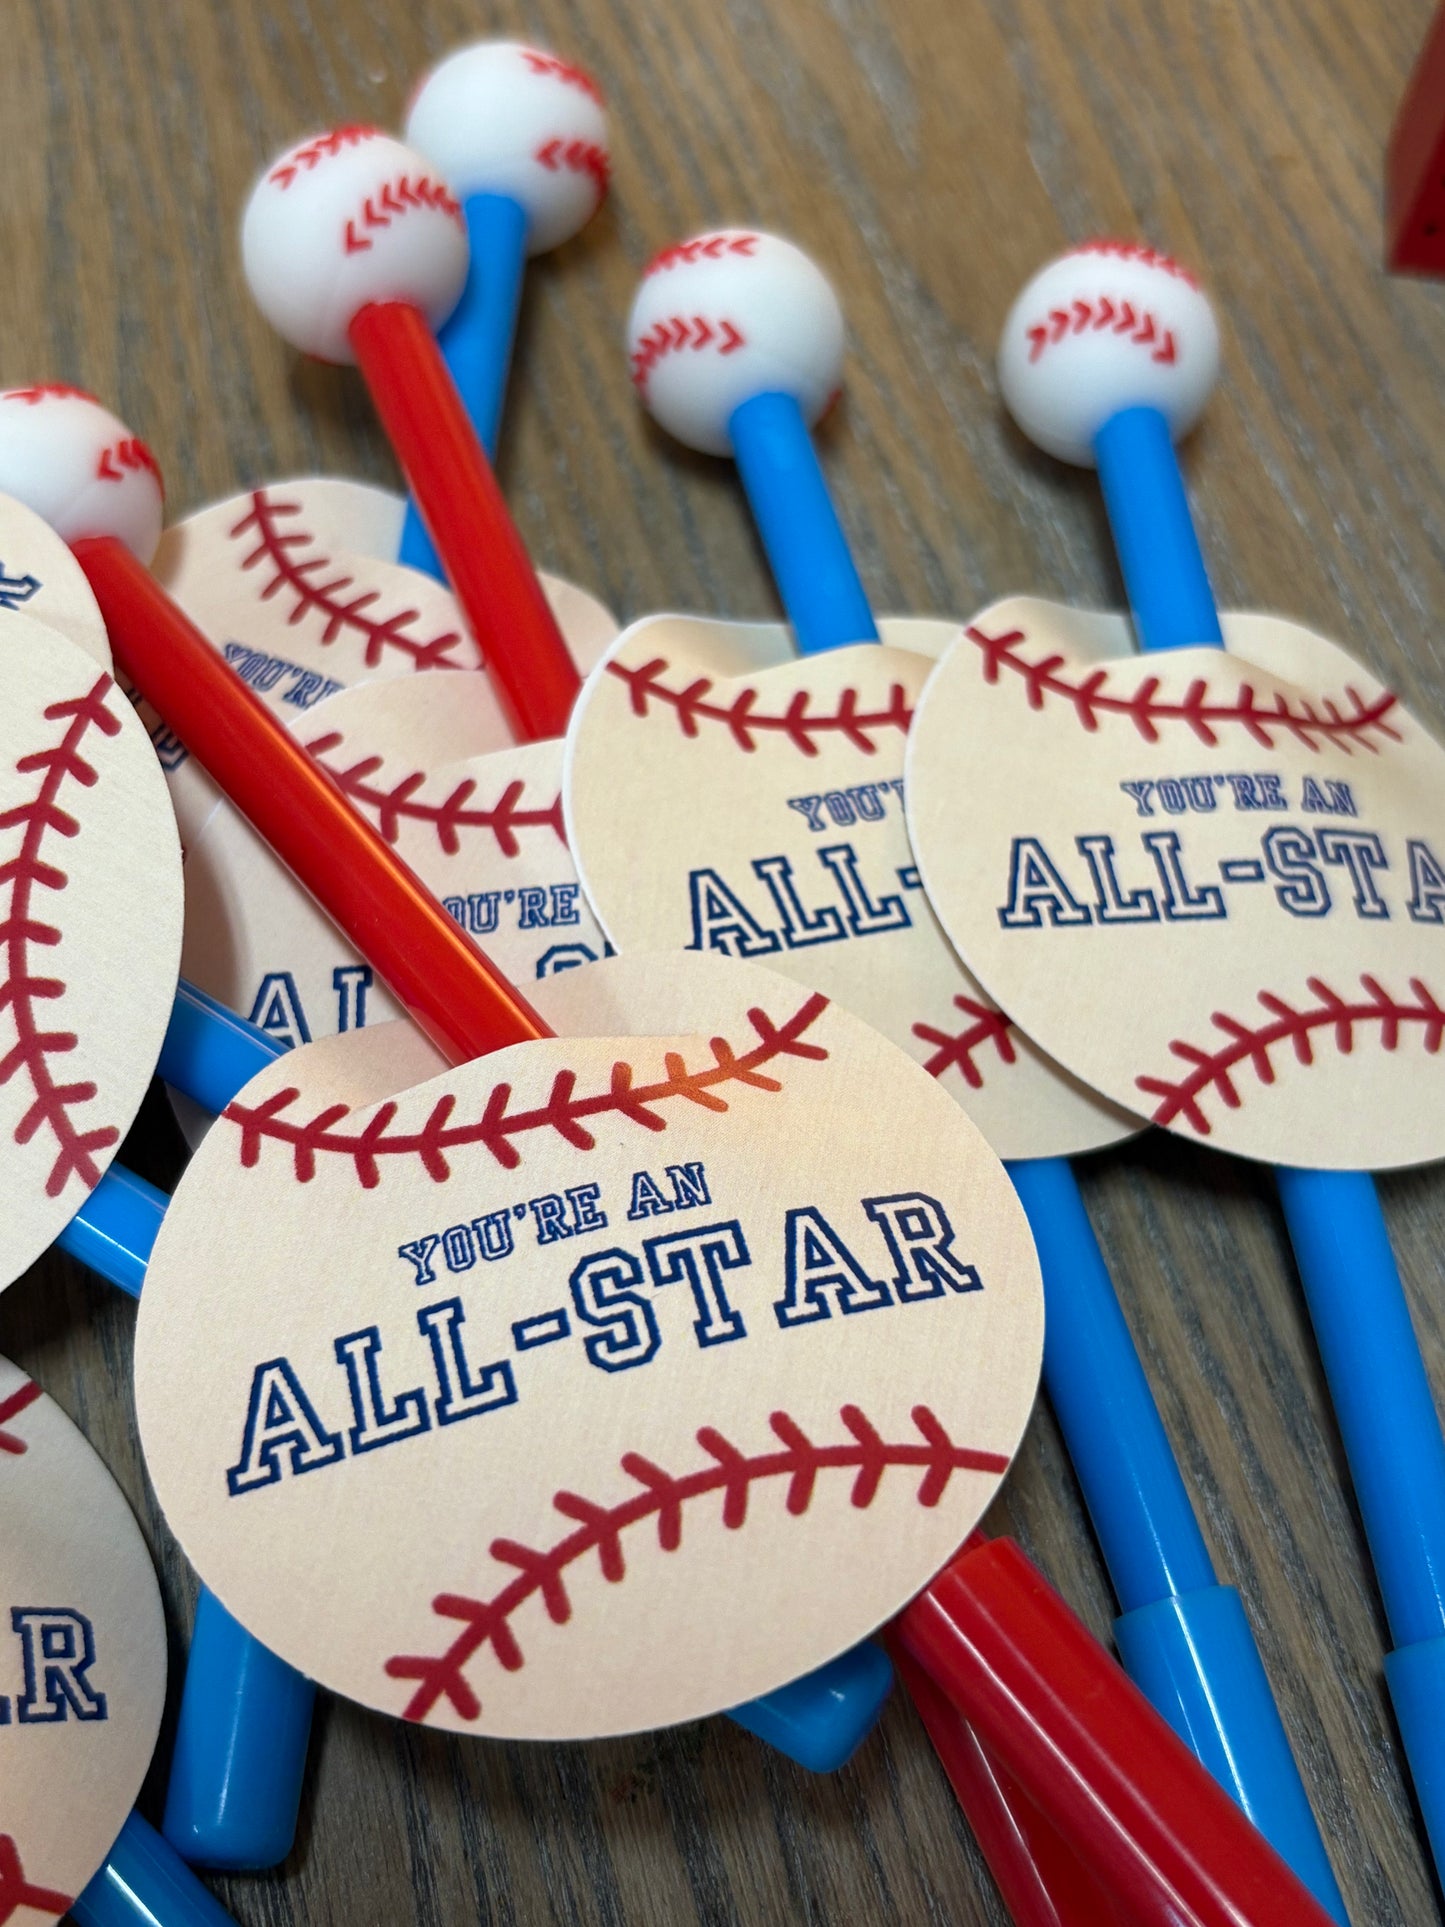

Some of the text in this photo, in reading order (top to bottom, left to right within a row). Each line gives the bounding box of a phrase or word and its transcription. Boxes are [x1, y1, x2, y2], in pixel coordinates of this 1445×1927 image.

[786, 778, 906, 832] YOU'
[1120, 773, 1357, 817] YOU'RE AN
[684, 843, 925, 958] ALL-
[997, 826, 1445, 928] ALL-STA
[400, 1162, 714, 1285] YOU'RE AN
[226, 1191, 985, 1497] ALL-STAR
